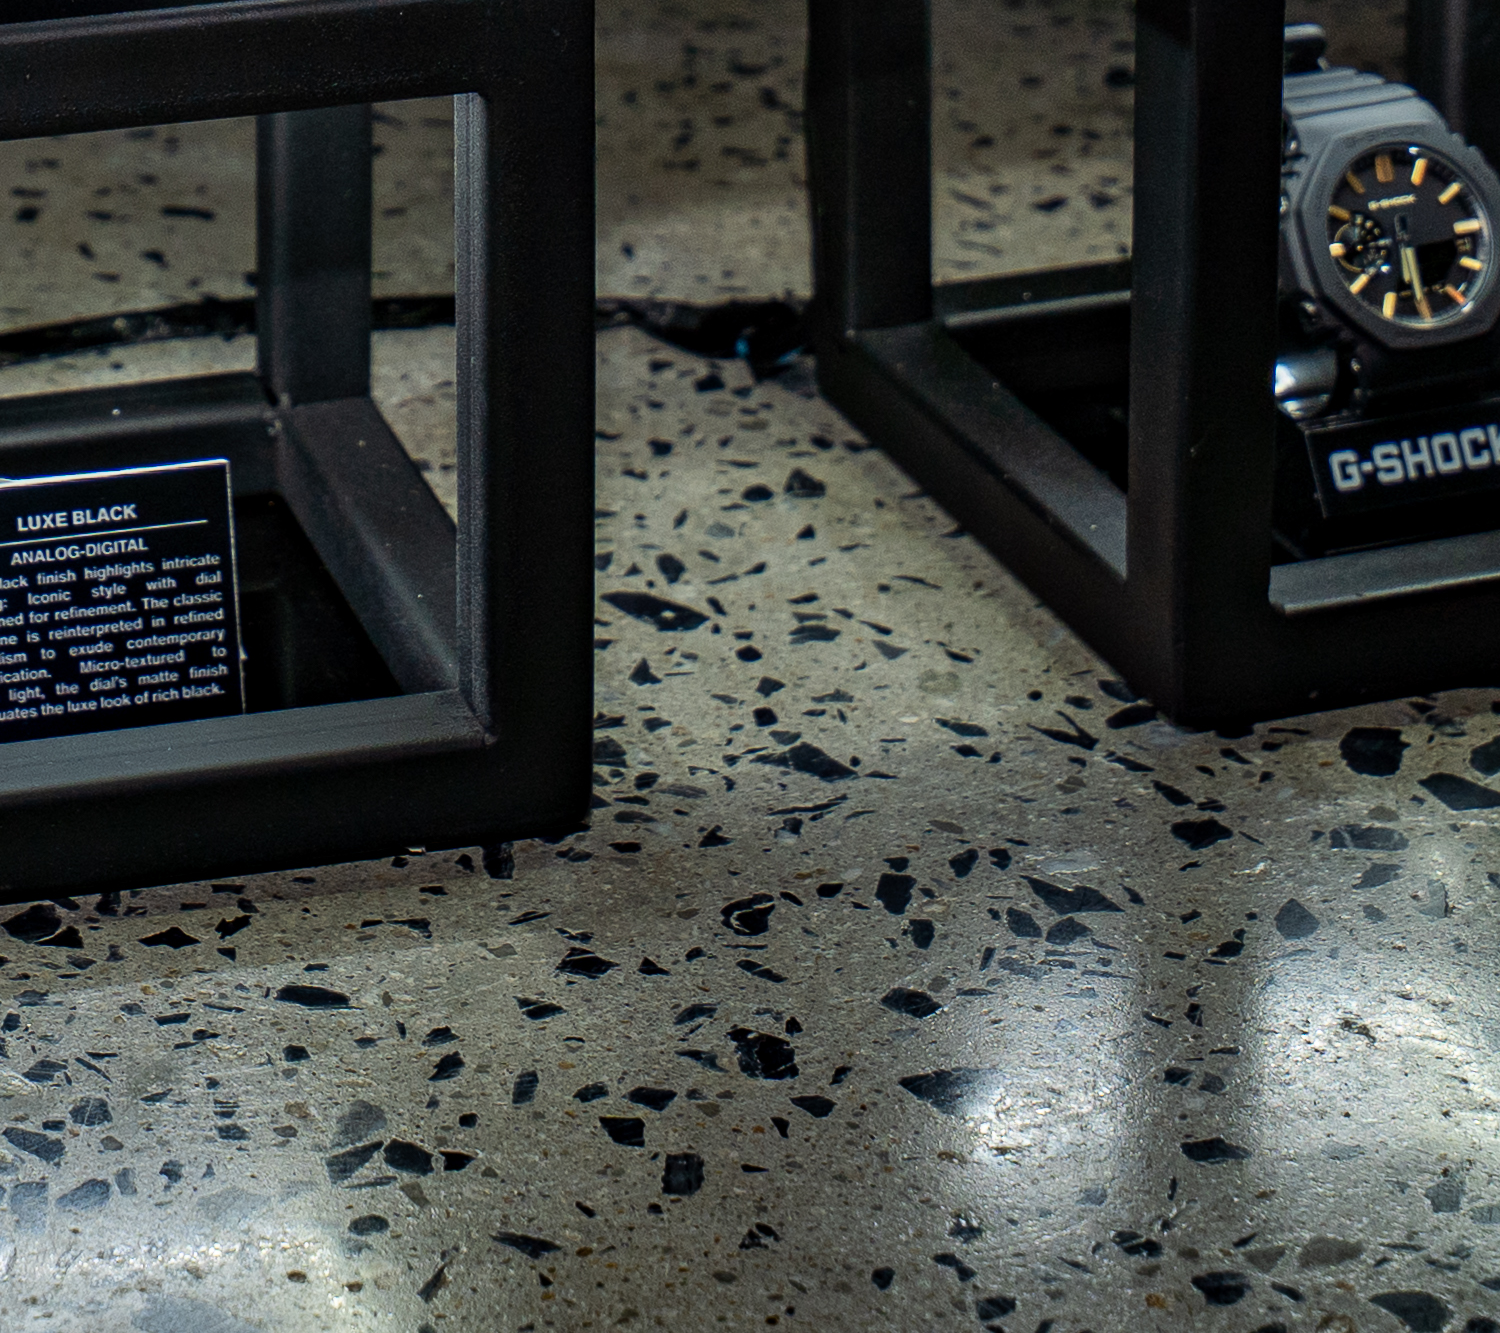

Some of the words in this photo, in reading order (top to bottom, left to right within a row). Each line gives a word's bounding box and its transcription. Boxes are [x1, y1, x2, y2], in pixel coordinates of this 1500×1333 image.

[16, 511, 69, 532] LUXE
[71, 503, 138, 526] BLACK
[10, 537, 150, 566] ANALOG-DIGITAL
[36, 569, 77, 586] finish
[83, 561, 155, 581] highlights
[161, 553, 221, 571] intricate
[27, 589, 72, 605] Iconic
[91, 583, 127, 600] style
[145, 577, 178, 591] with
[195, 570, 223, 585] dial
[28, 611, 50, 624] for
[54, 600, 138, 621] refinement.
[140, 597, 170, 610] The
[173, 590, 223, 607] classic
[26, 630, 41, 643] is
[48, 616, 143, 640] reinterpreted
[151, 615, 166, 628] in
[173, 607, 225, 625] refined
[40, 648, 57, 660] to
[68, 640, 114, 657] exude
[125, 628, 226, 649] contemporary
[79, 649, 186, 674] Micro-textured
[211, 645, 228, 658] to
[8, 686, 46, 703] light,
[54, 683, 80, 696] the
[137, 670, 180, 686] matte
[188, 663, 229, 679] finish
[40, 703, 65, 716] the
[66, 700, 98, 713] luxe
[100, 693, 132, 709] look
[134, 690, 150, 705] of
[152, 687, 180, 703] rich
[181, 682, 226, 699] black.
